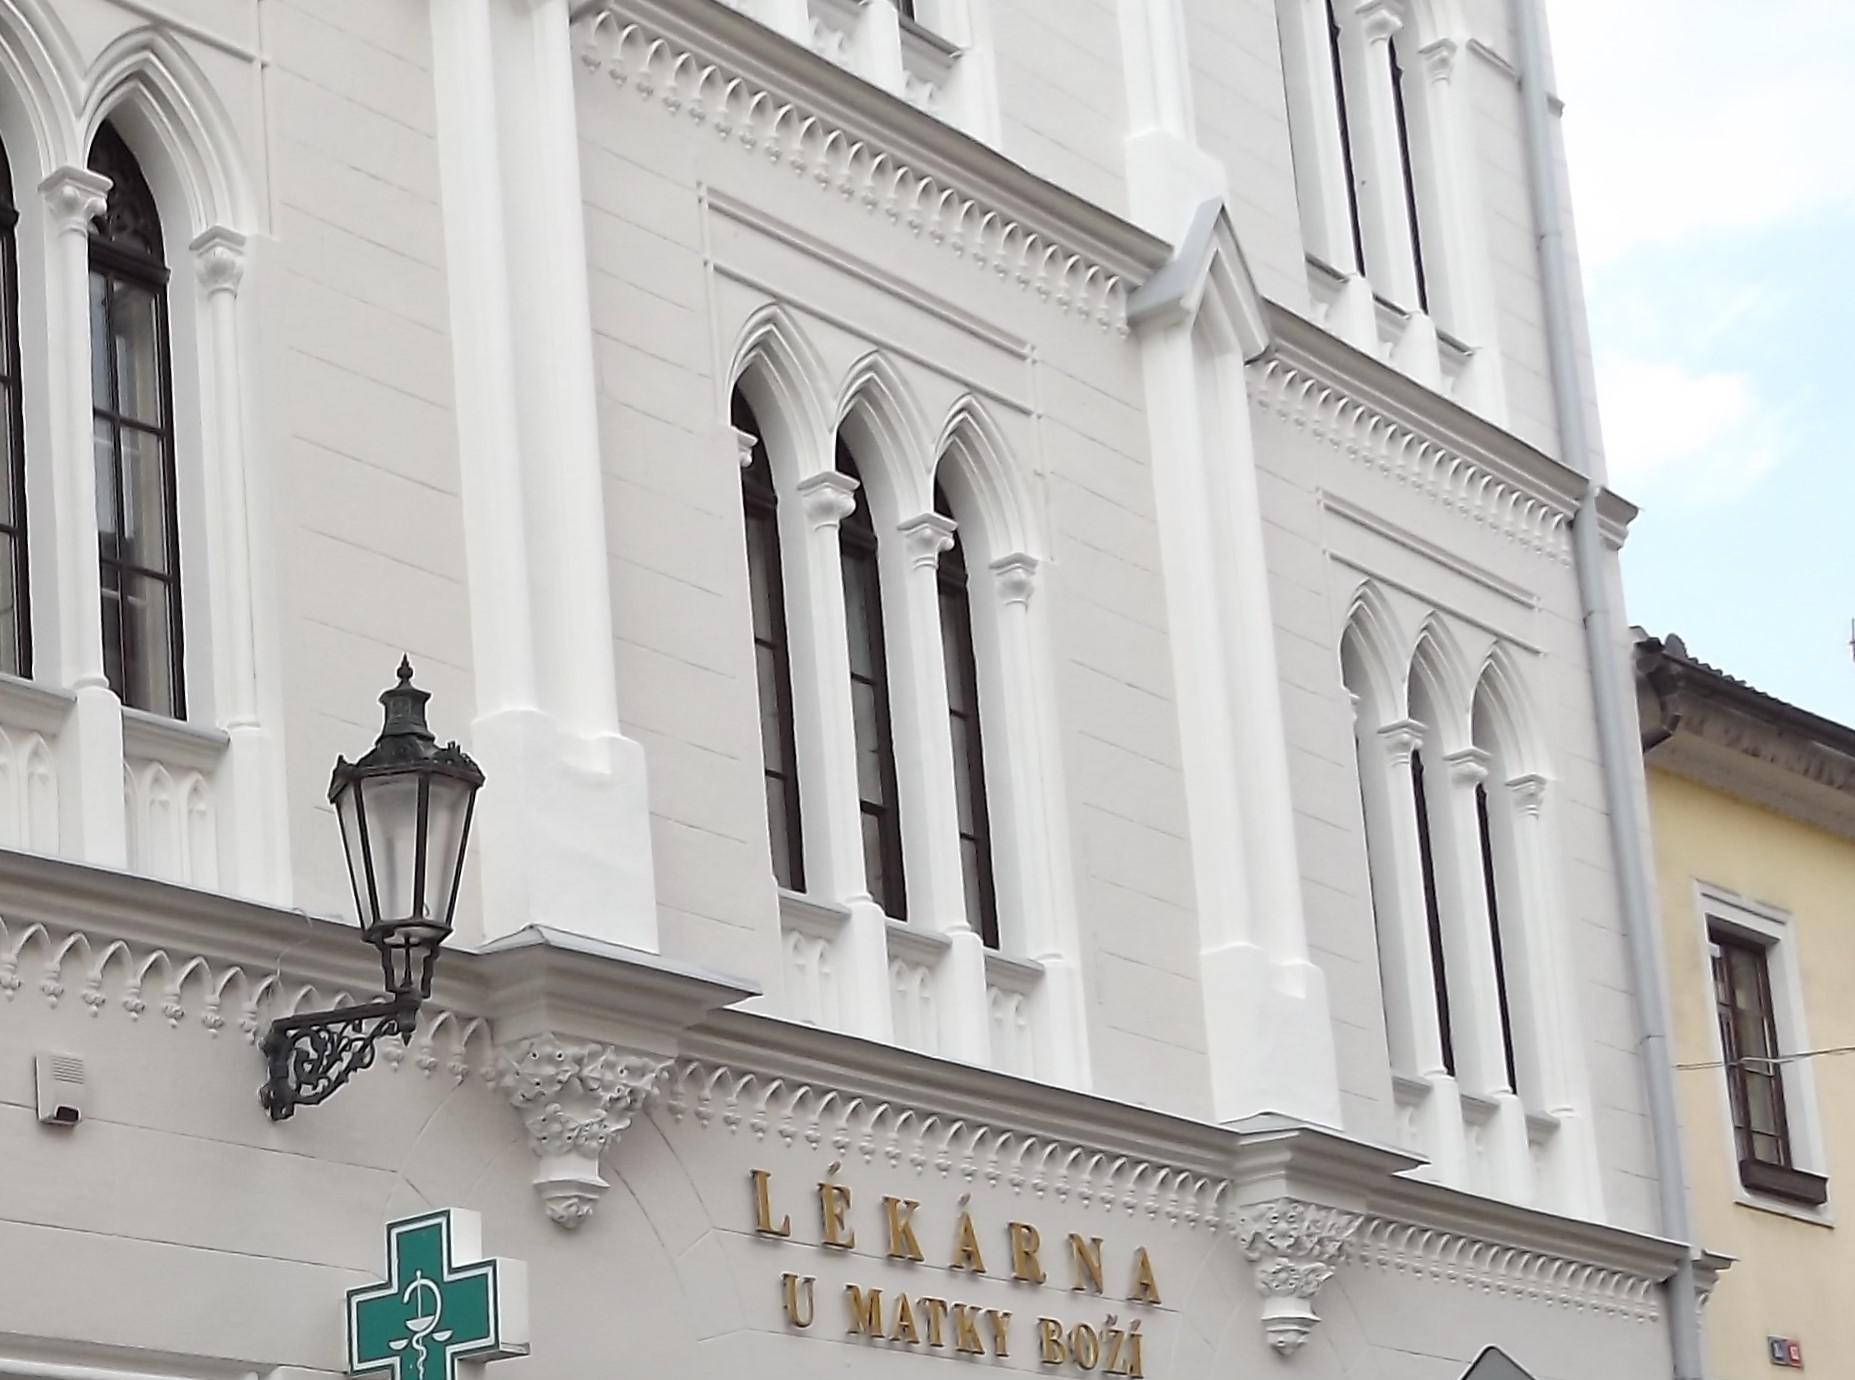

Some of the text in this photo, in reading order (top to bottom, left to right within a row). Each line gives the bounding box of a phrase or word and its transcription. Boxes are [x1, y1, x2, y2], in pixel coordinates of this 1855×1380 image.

[749, 1160, 1162, 1305] LÉKÁRNA
[781, 1272, 1145, 1380] U MATKY BOŽÍ
